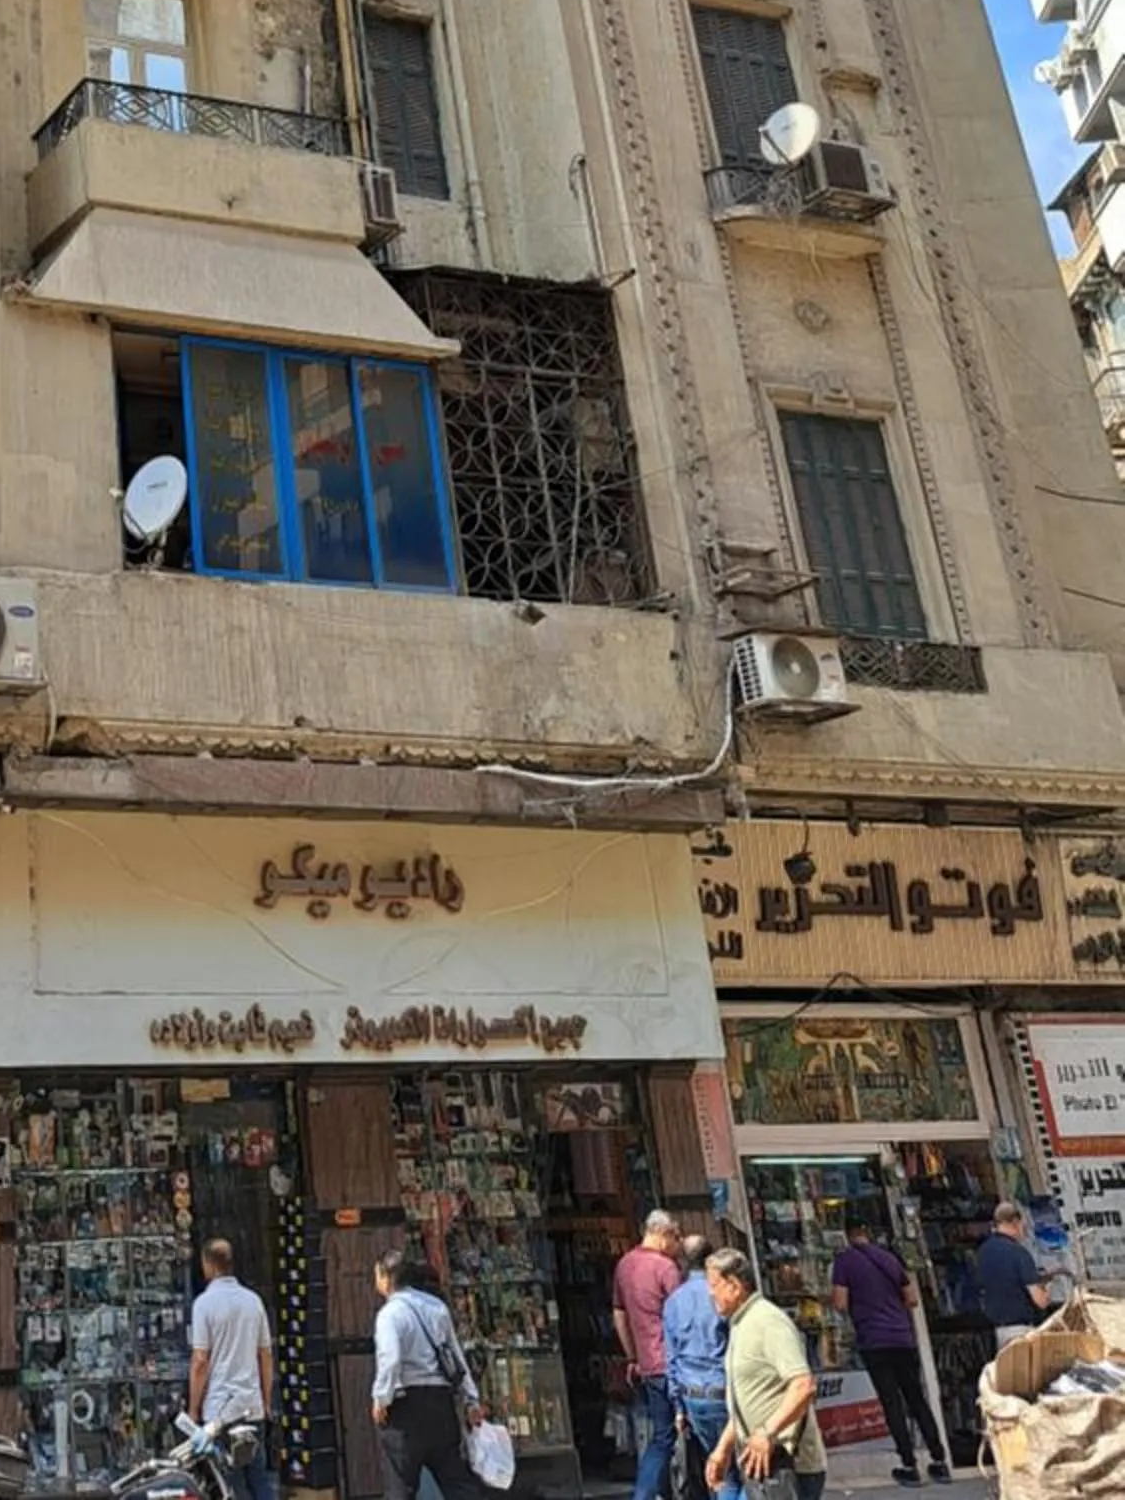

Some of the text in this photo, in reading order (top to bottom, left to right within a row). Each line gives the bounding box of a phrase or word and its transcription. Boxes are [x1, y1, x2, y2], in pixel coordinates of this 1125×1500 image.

[353, 852, 465, 920] راديو
[908, 857, 1044, 936] فوتو
[1074, 1210, 1122, 1227] PHOTO
